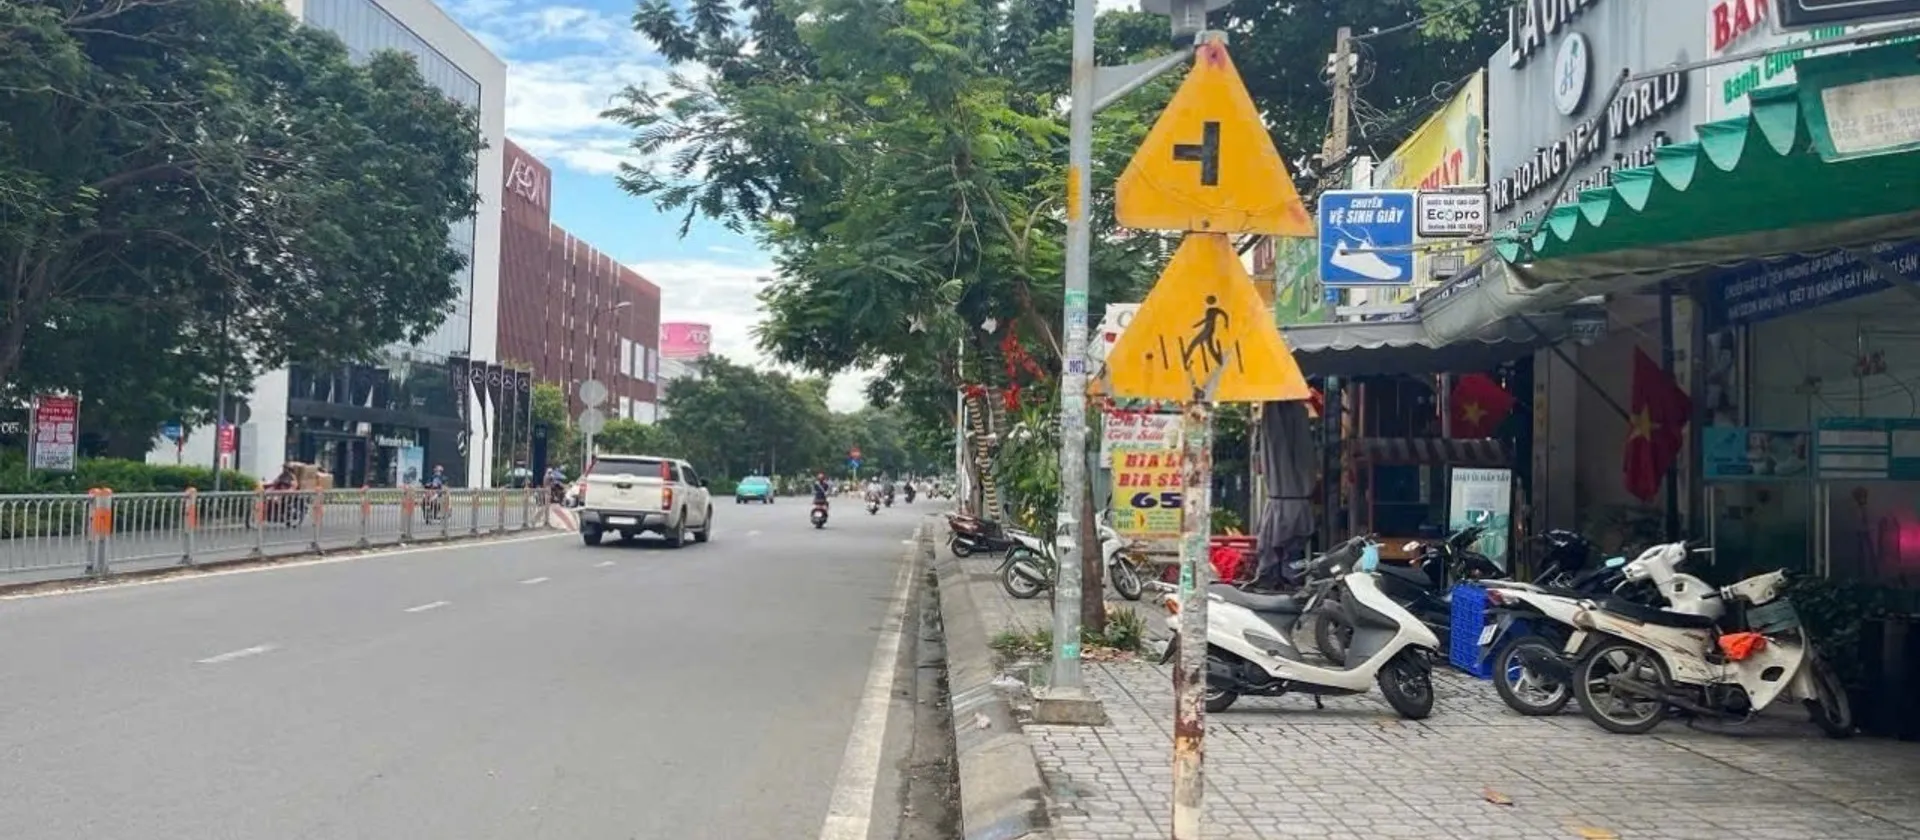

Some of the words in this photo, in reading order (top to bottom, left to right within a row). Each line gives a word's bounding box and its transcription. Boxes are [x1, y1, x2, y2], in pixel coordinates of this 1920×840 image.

[1492, 177, 1509, 213] MR
[1608, 72, 1681, 137] WORLD
[506, 156, 548, 211] AEON
[1346, 209, 1374, 224] SINH
[1427, 208, 1480, 221] Ecopro
